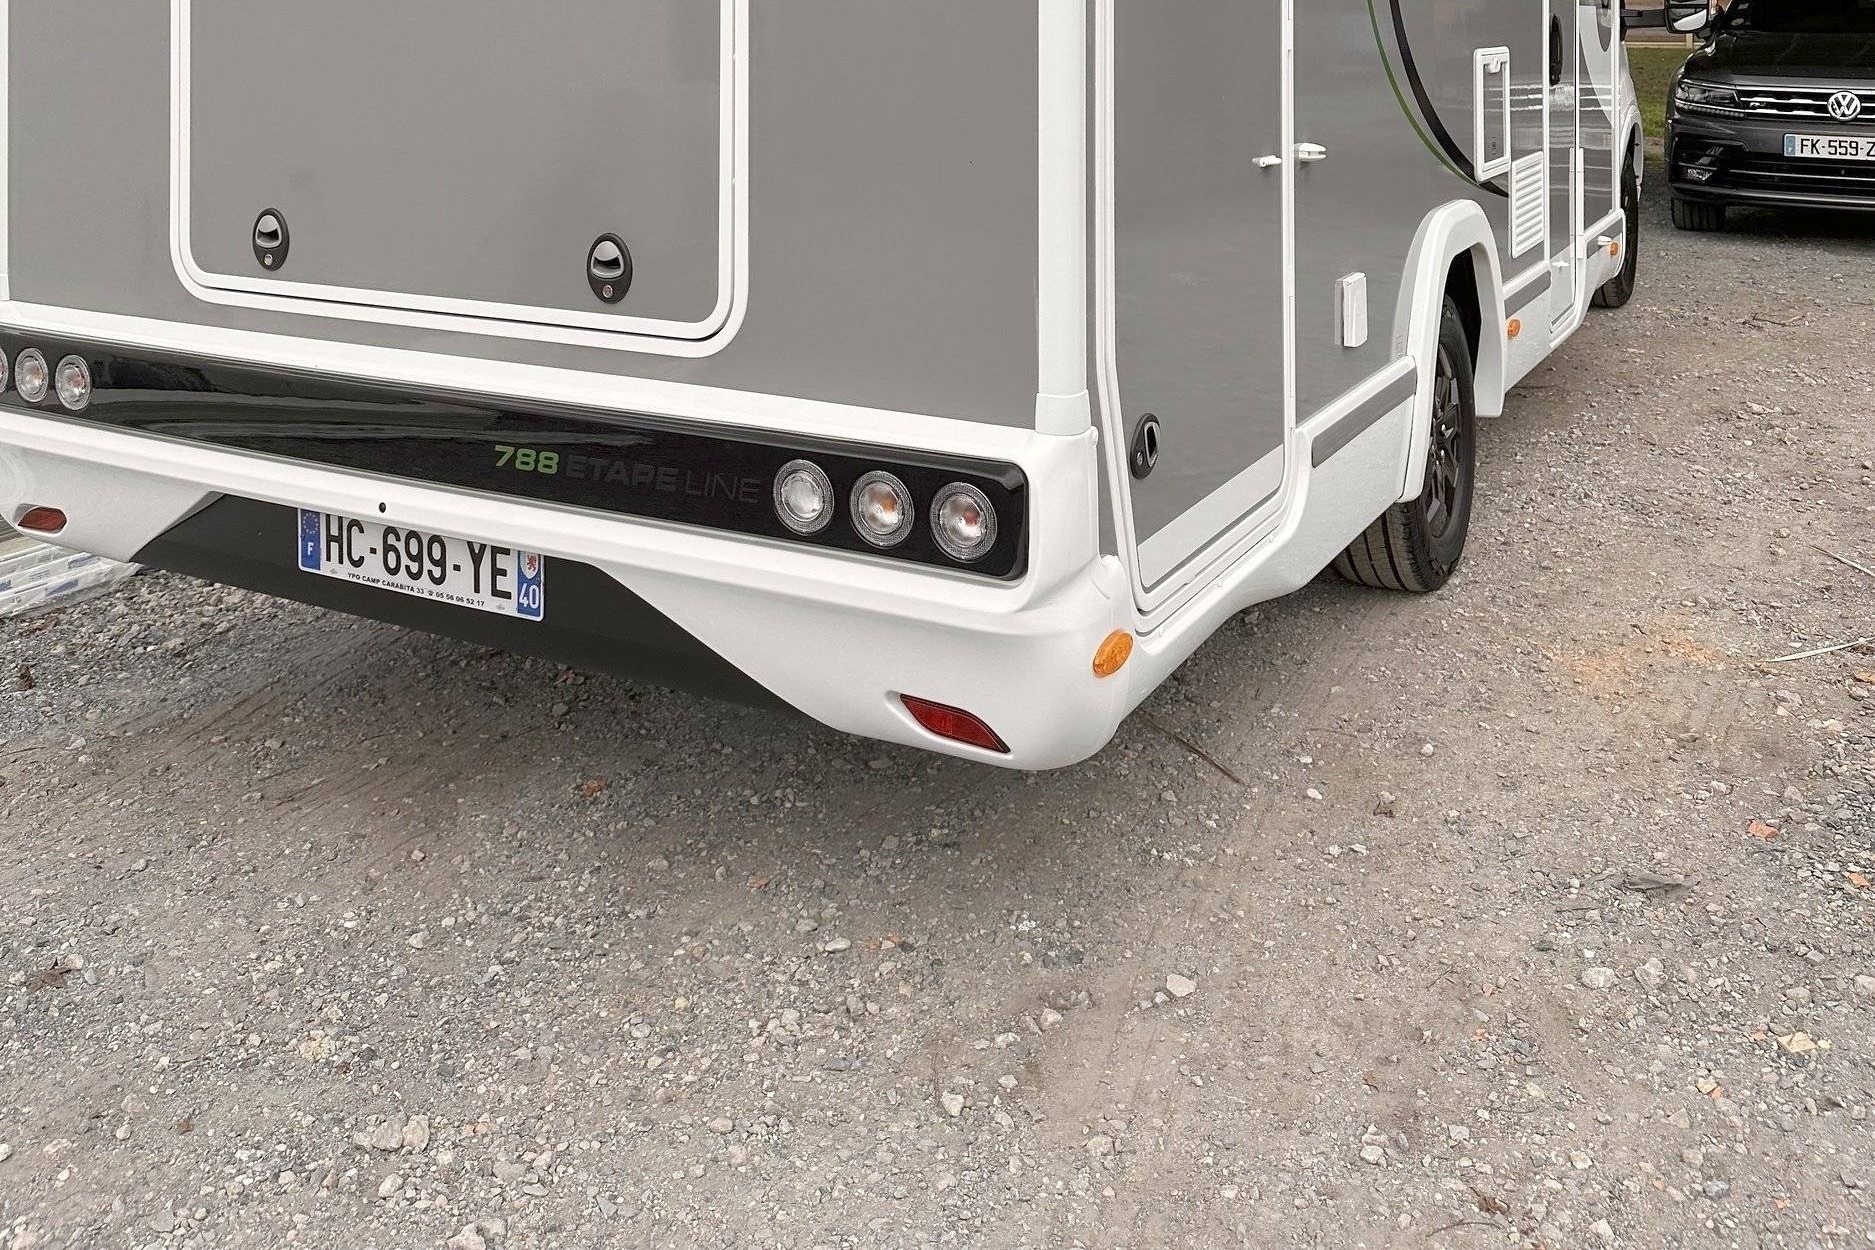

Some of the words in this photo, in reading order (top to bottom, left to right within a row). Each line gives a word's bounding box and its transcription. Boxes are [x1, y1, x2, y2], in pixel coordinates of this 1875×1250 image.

[493, 445, 560, 475] 788
[566, 454, 679, 492] ETAPE
[685, 470, 761, 504] LINE
[307, 541, 315, 556] F
[325, 514, 512, 600] HC-699-YE
[347, 572, 361, 580] YPO
[362, 575, 380, 585] CAMP
[382, 579, 415, 593] CARABITA
[416, 587, 425, 595] 33
[519, 582, 540, 610] 40
